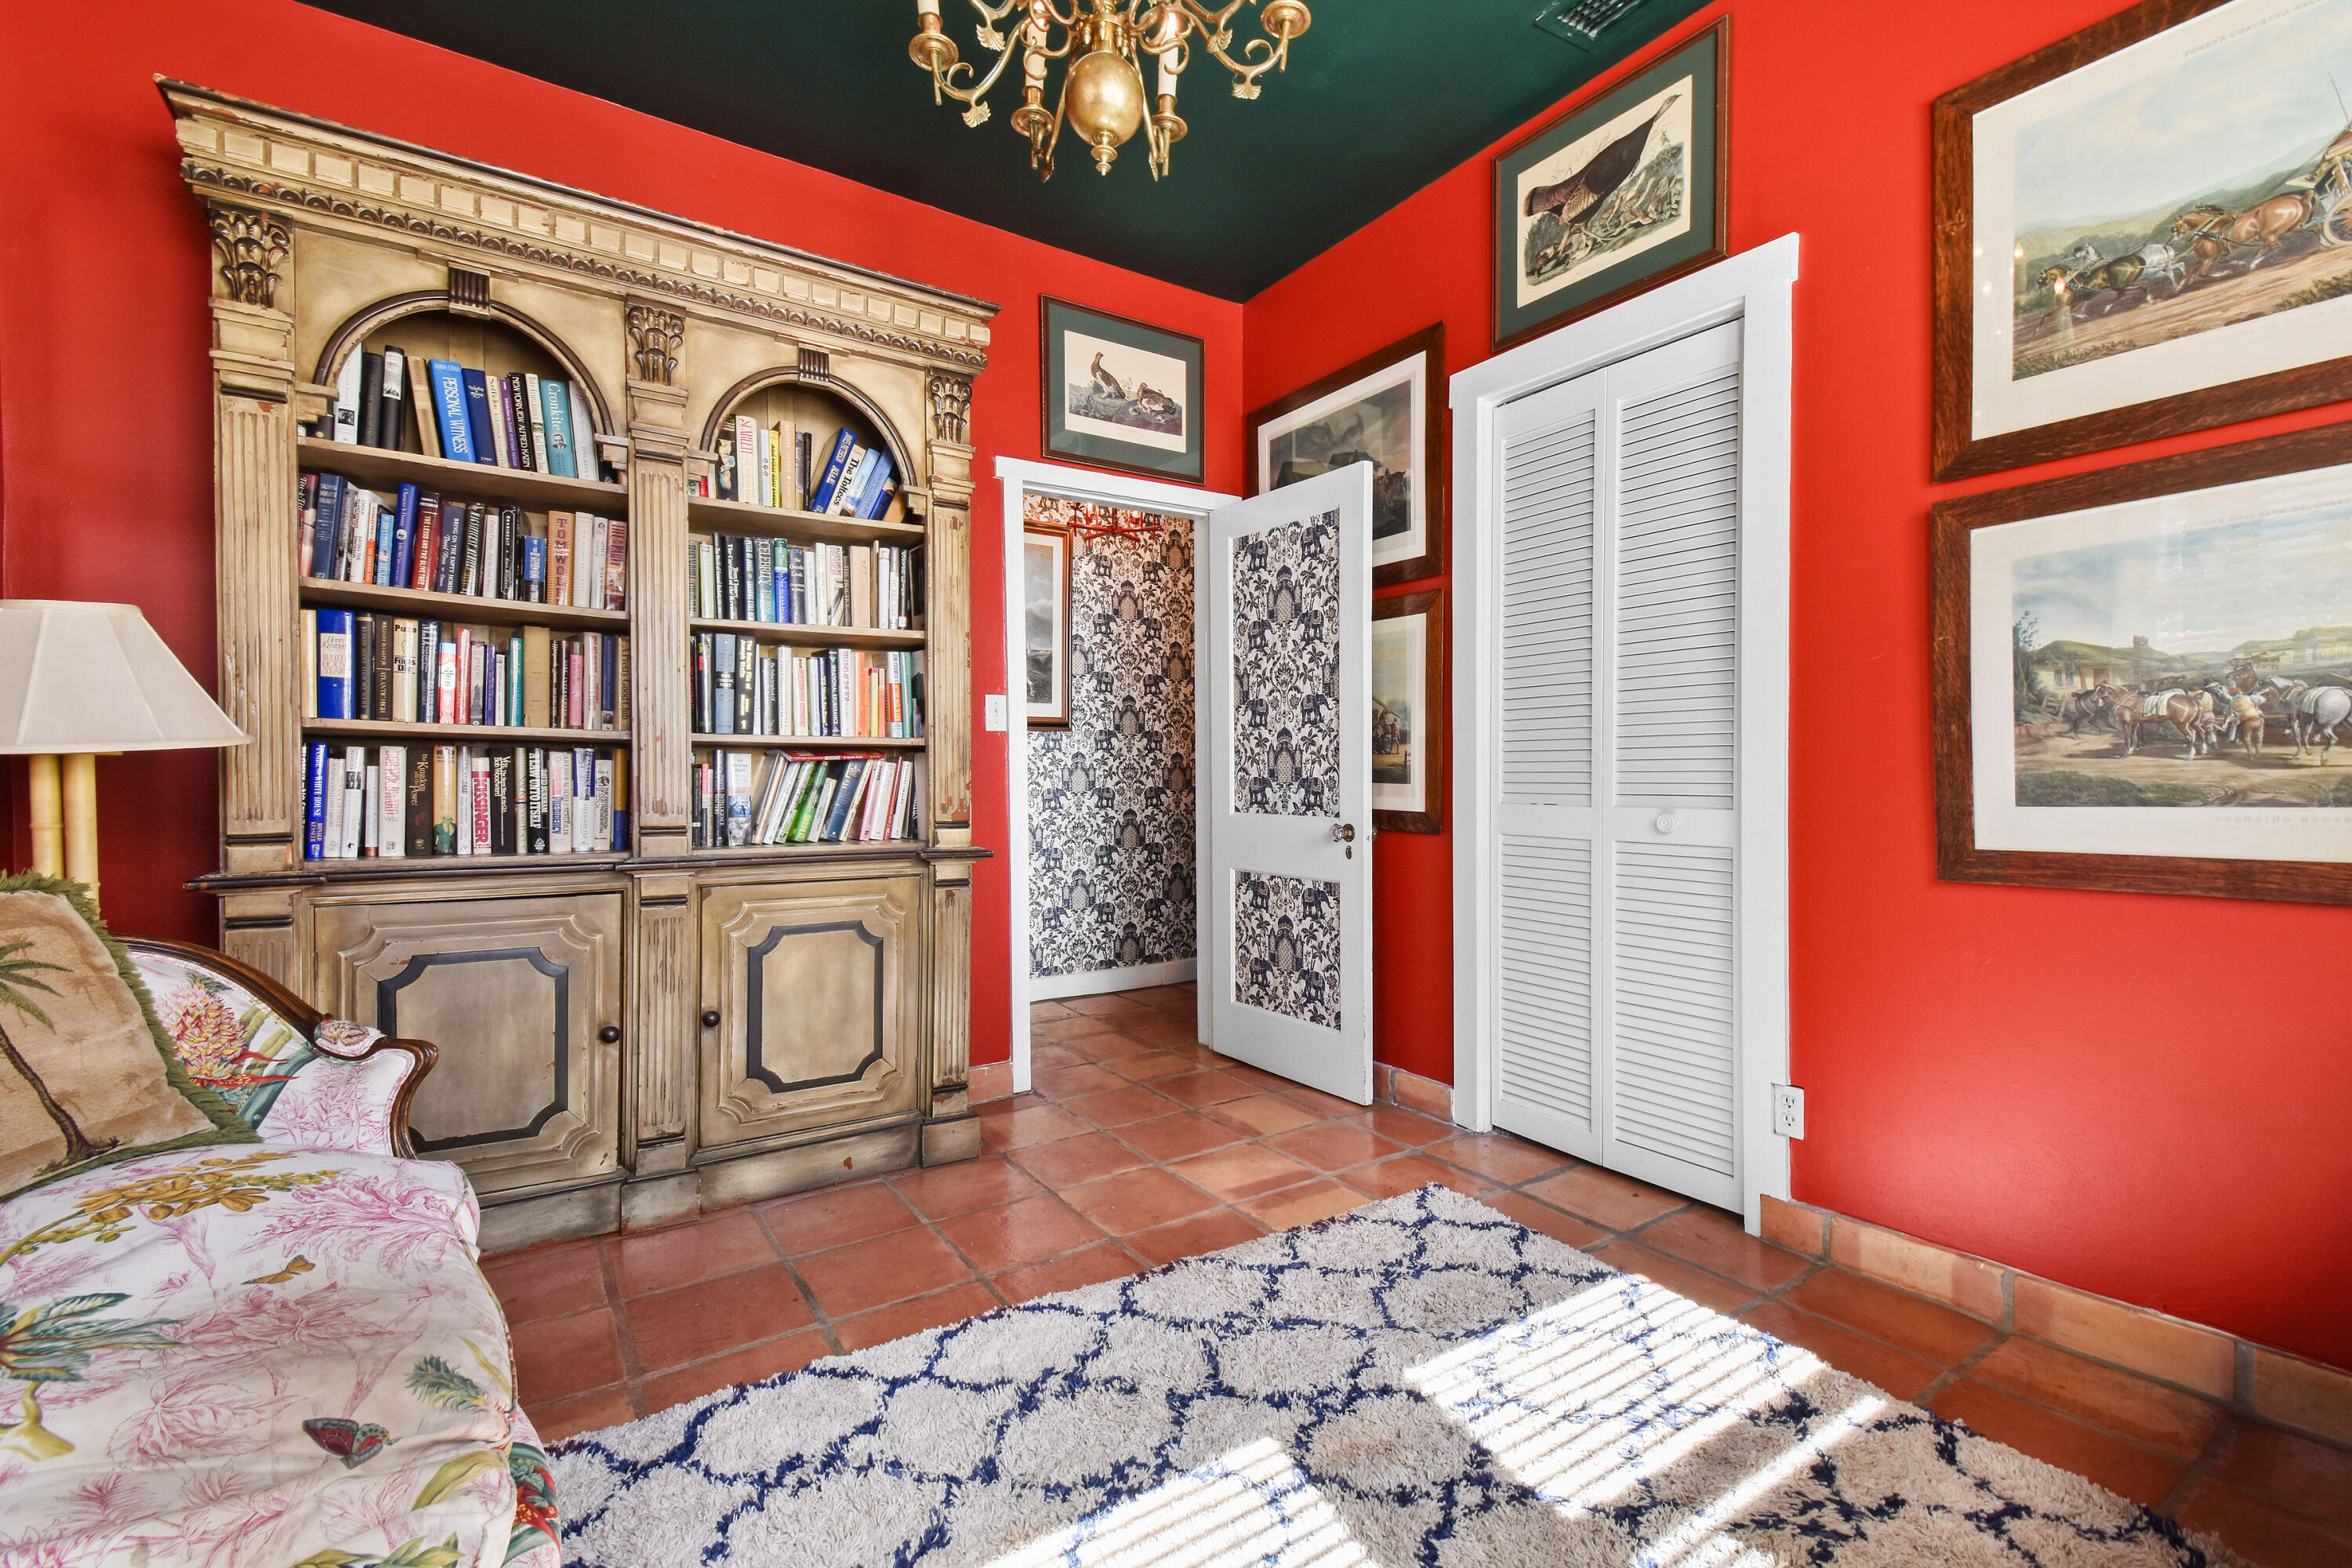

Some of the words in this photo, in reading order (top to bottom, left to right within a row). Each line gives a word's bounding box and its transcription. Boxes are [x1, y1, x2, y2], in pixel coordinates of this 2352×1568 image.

[511, 376, 521, 393] NEW
[442, 376, 459, 418] PERSONAL
[514, 393, 523, 409] YORK
[548, 383, 564, 431] Cronkite
[449, 419, 469, 454] WITNESS
[518, 424, 528, 448] ALFRED
[521, 448, 531, 468] KAZIN
[846, 458, 860, 475] The
[833, 475, 853, 506] Toltecs
[452, 535, 459, 543] ON
[758, 541, 772, 586] CELEBRITY
[417, 572, 426, 586] TREE
[446, 574, 455, 594] HORSES
[620, 654, 630, 677] Pretty
[621, 679, 630, 701] Good
[621, 701, 630, 720] Club
[494, 757, 503, 768] Bob
[529, 759, 541, 779] LAW
[314, 775, 323, 796] WHITE
[416, 761, 429, 792] Kingdom
[494, 768, 503, 797] Woodward
[408, 786, 421, 807] Power
[529, 779, 541, 800] UNTO
[313, 797, 322, 818] HOUSE
[473, 778, 489, 844] KISSINGER
[529, 800, 541, 829] ITSELF
[551, 796, 564, 835] PRESIDENCY
[800, 815, 812, 833] HOURS
